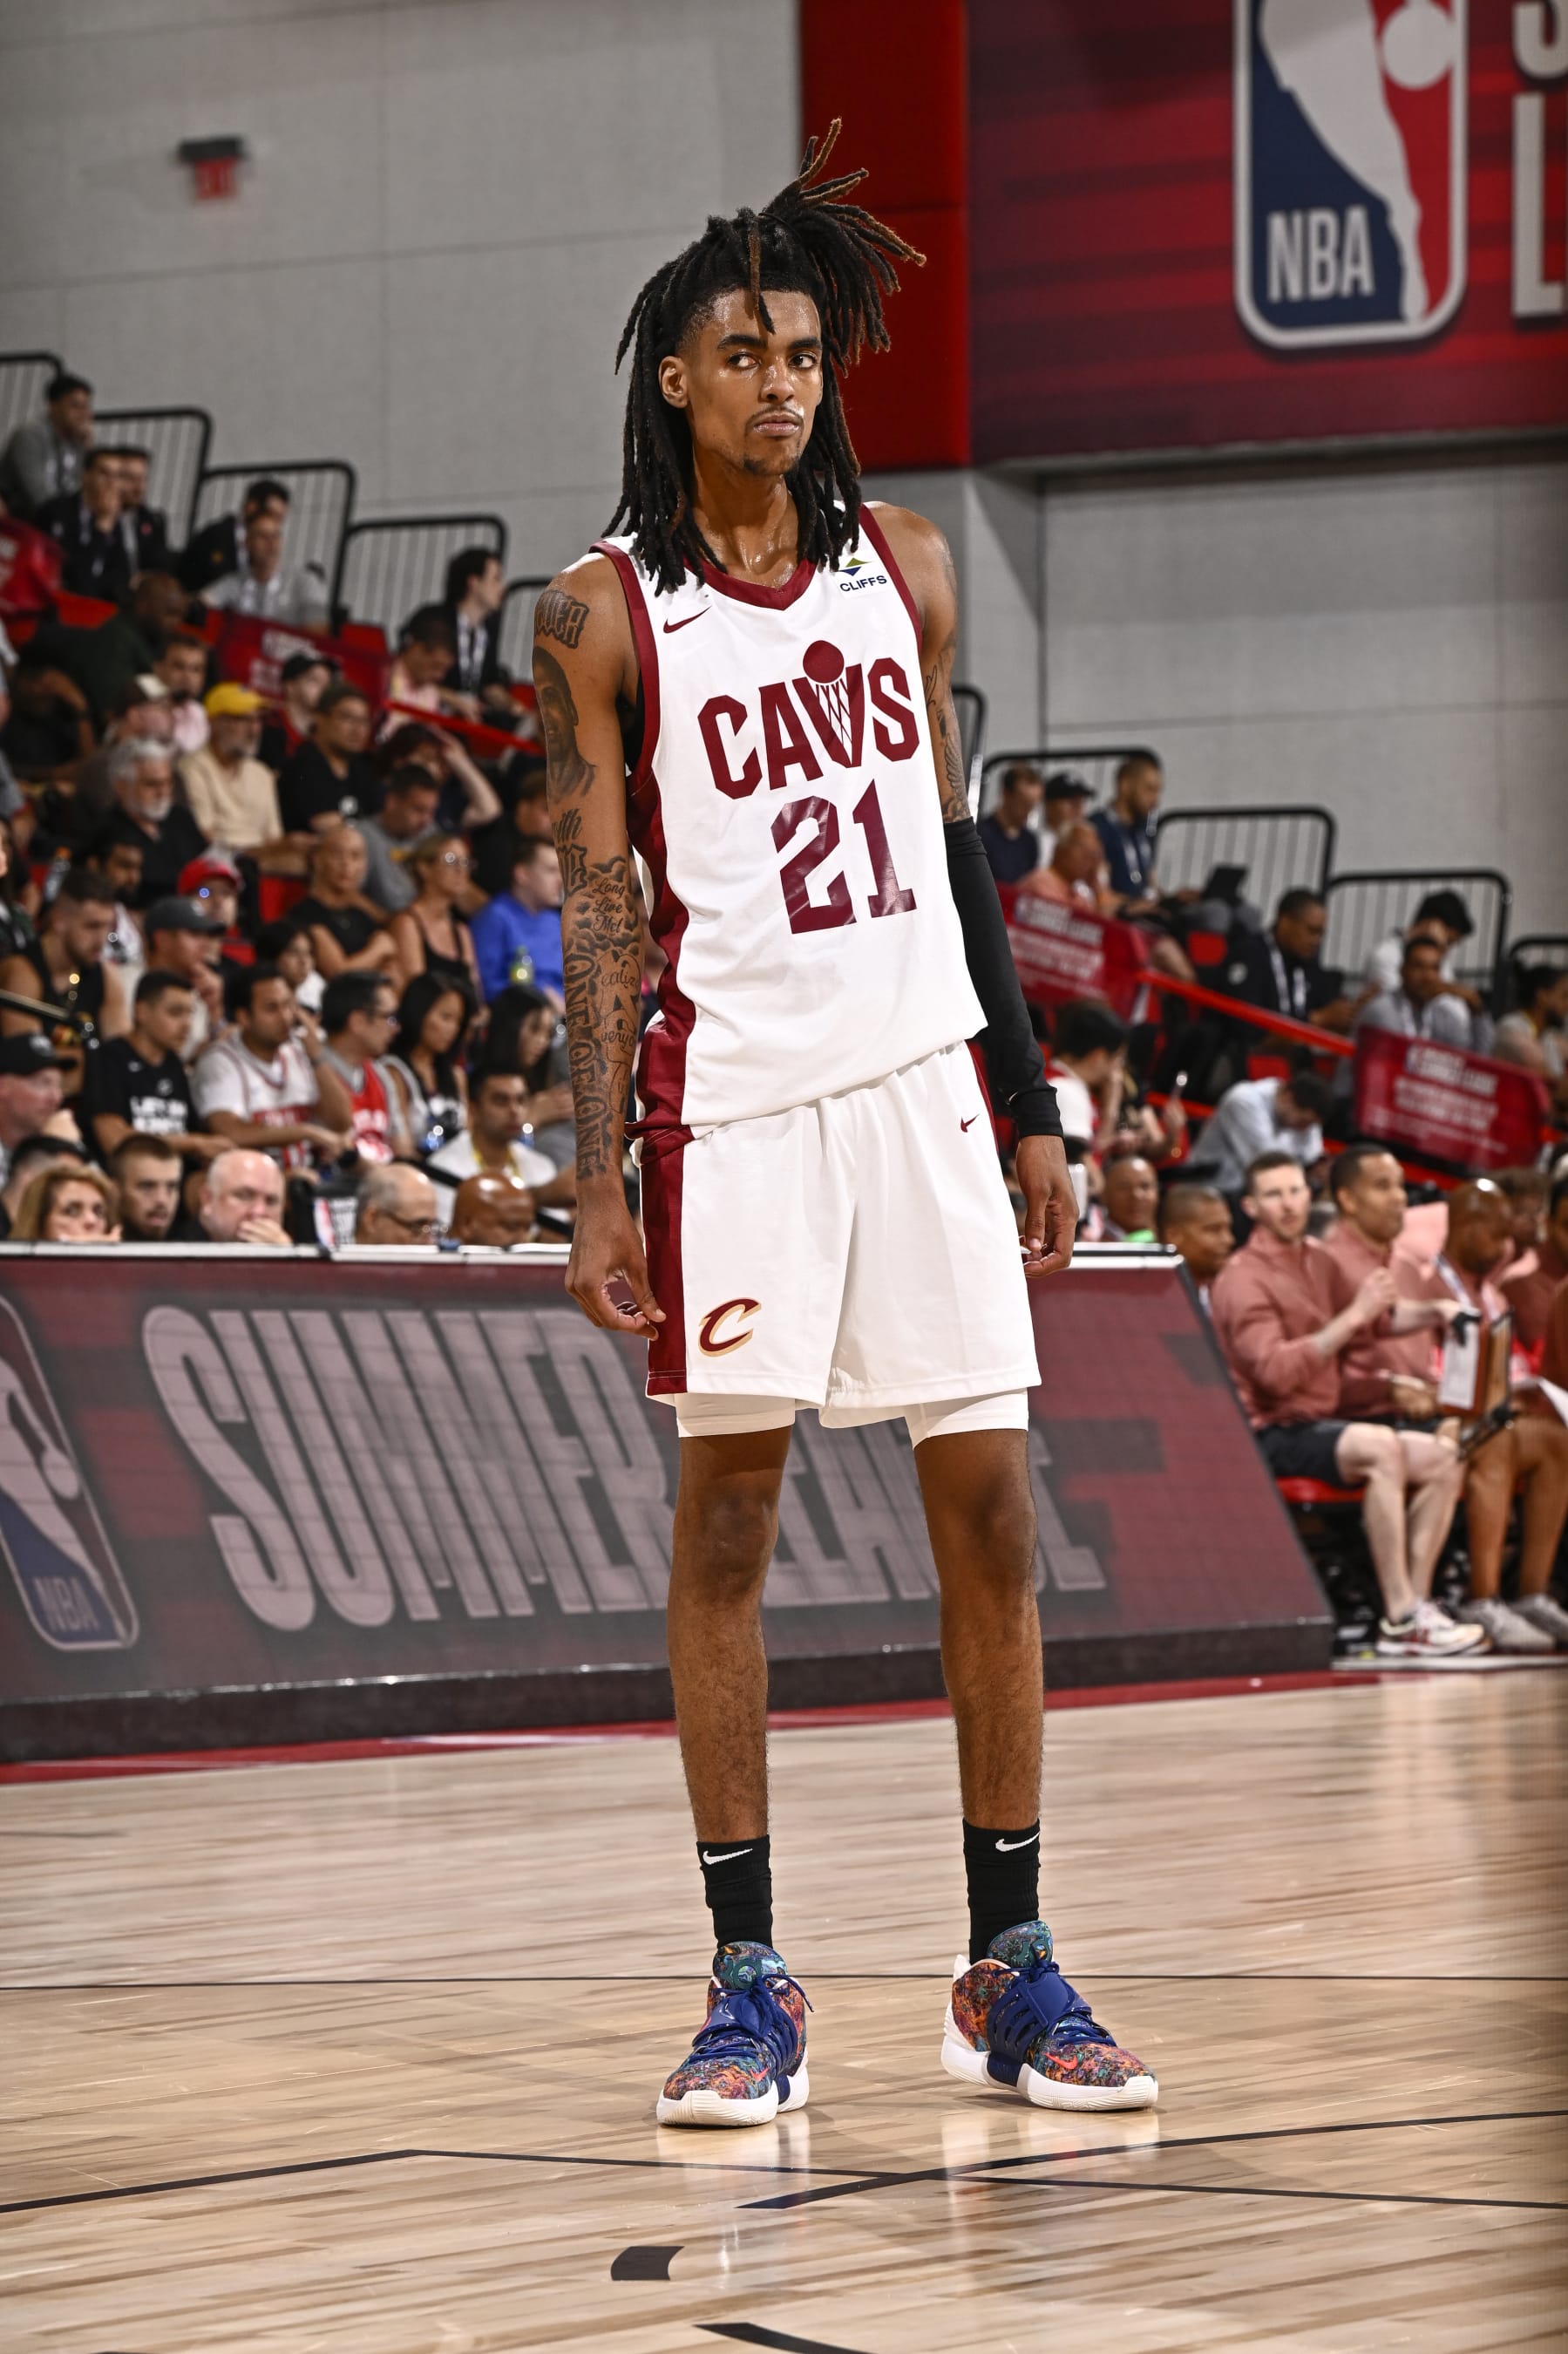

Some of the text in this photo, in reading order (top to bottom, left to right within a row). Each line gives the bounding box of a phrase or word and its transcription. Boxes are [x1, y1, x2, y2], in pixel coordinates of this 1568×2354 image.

[1266, 205, 1375, 303] NBA
[839, 575, 887, 592] CLIFFS
[697, 656, 920, 800] CAVS
[592, 877, 626, 899] Long
[770, 779, 917, 935] 21
[697, 1297, 762, 1357] C
[142, 1305, 675, 1632] SUMMER
[33, 1576, 101, 1631] NBA
